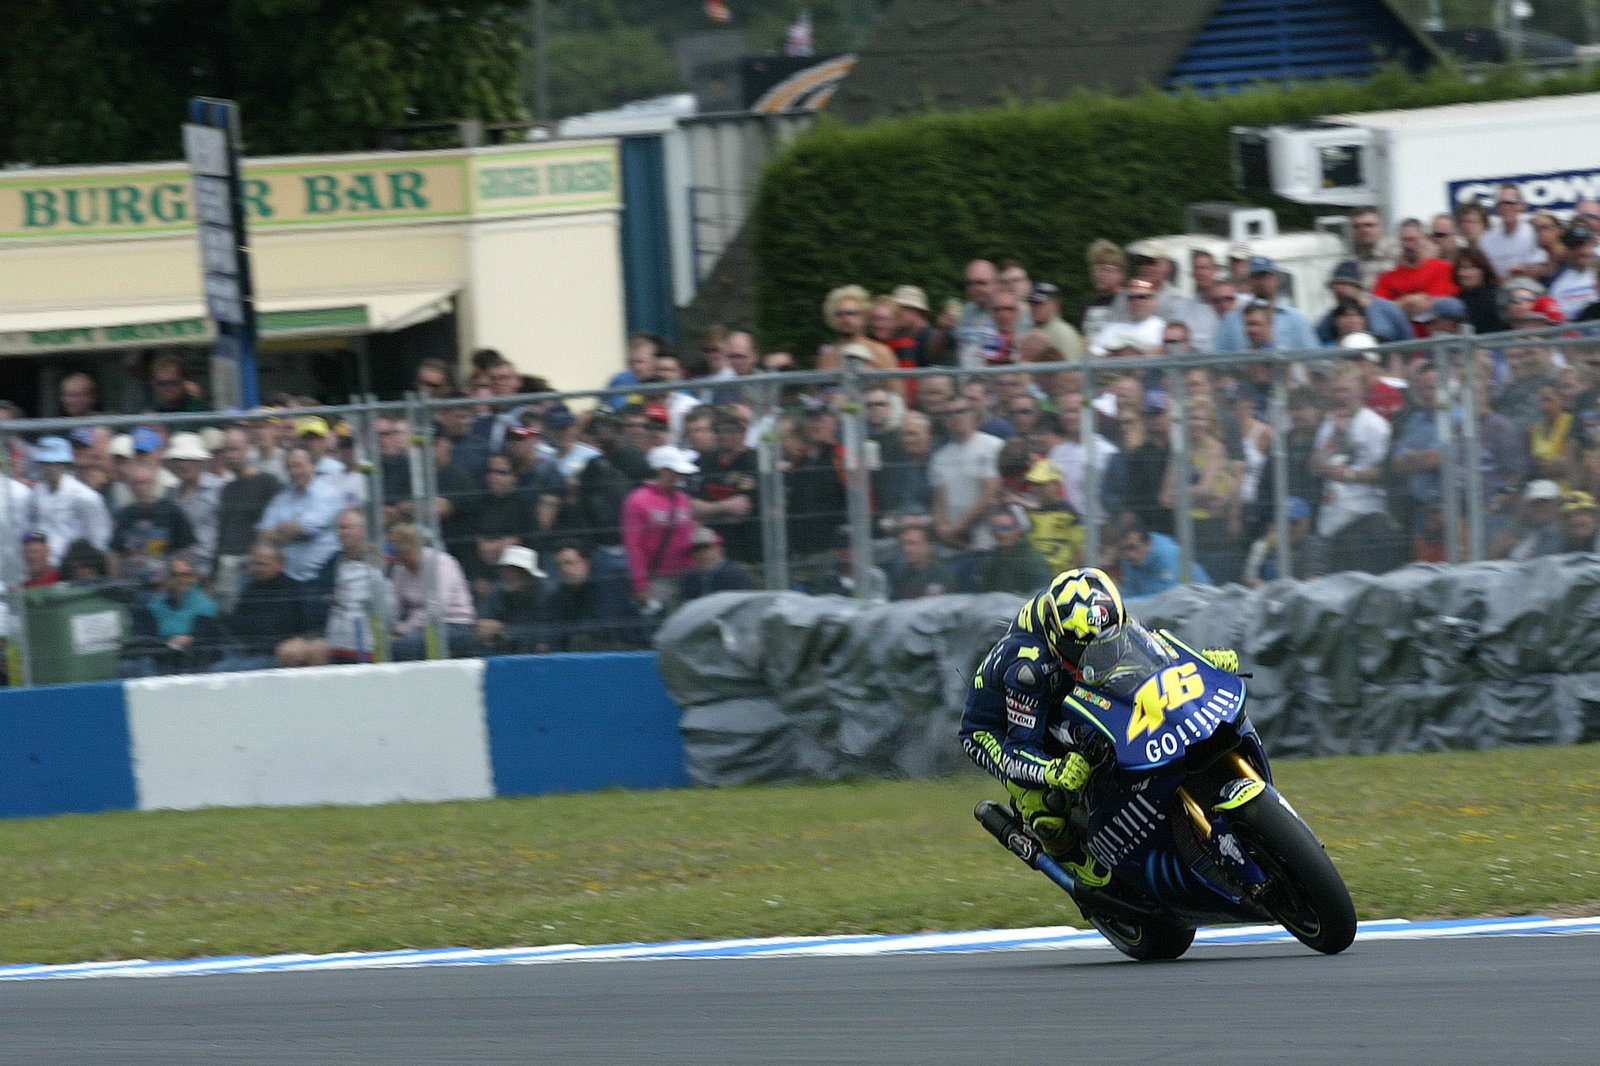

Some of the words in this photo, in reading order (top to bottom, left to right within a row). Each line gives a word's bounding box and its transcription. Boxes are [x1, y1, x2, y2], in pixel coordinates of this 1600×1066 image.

[22, 178, 273, 228] BURGR
[303, 171, 430, 214] BAR
[1127, 661, 1205, 745] 46
[1002, 752, 1046, 784] YAMAHA
